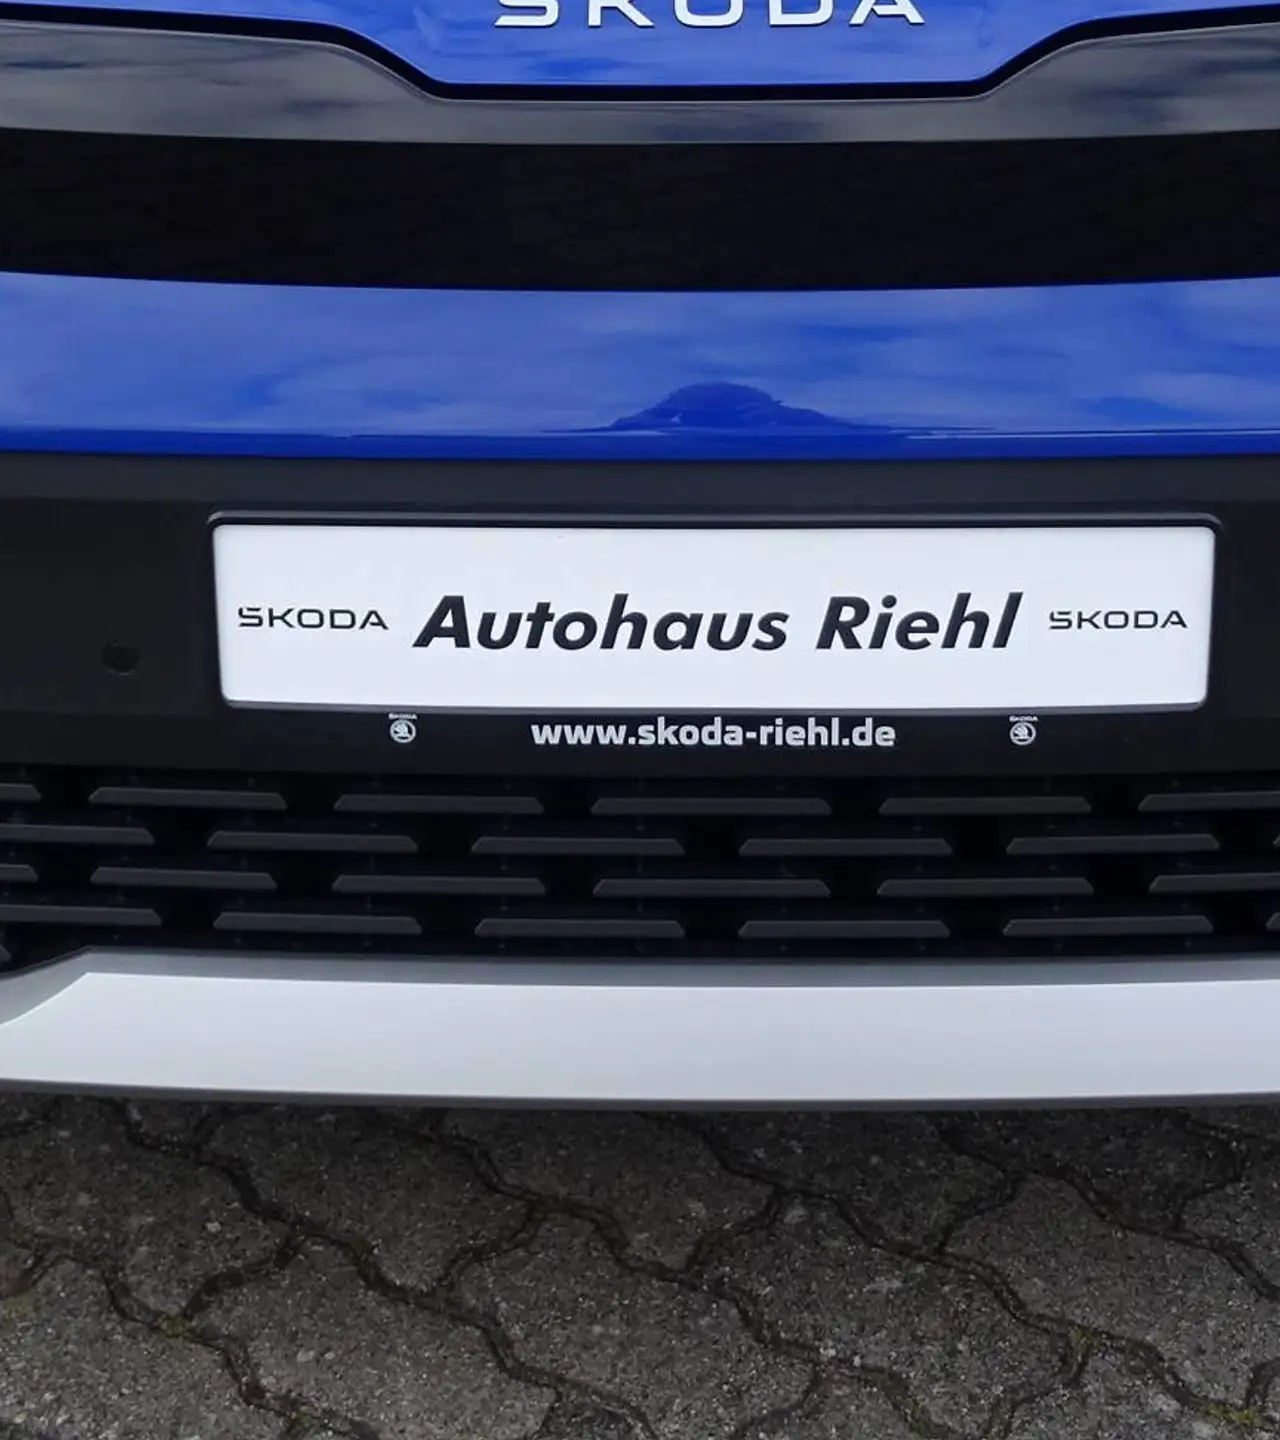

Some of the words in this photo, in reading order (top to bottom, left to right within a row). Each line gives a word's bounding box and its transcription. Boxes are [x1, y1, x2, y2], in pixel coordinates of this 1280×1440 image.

[412, 593, 790, 651] Autohaus
[816, 591, 1024, 651] Riehl
[530, 715, 896, 747] www.skoda-riehl.de
